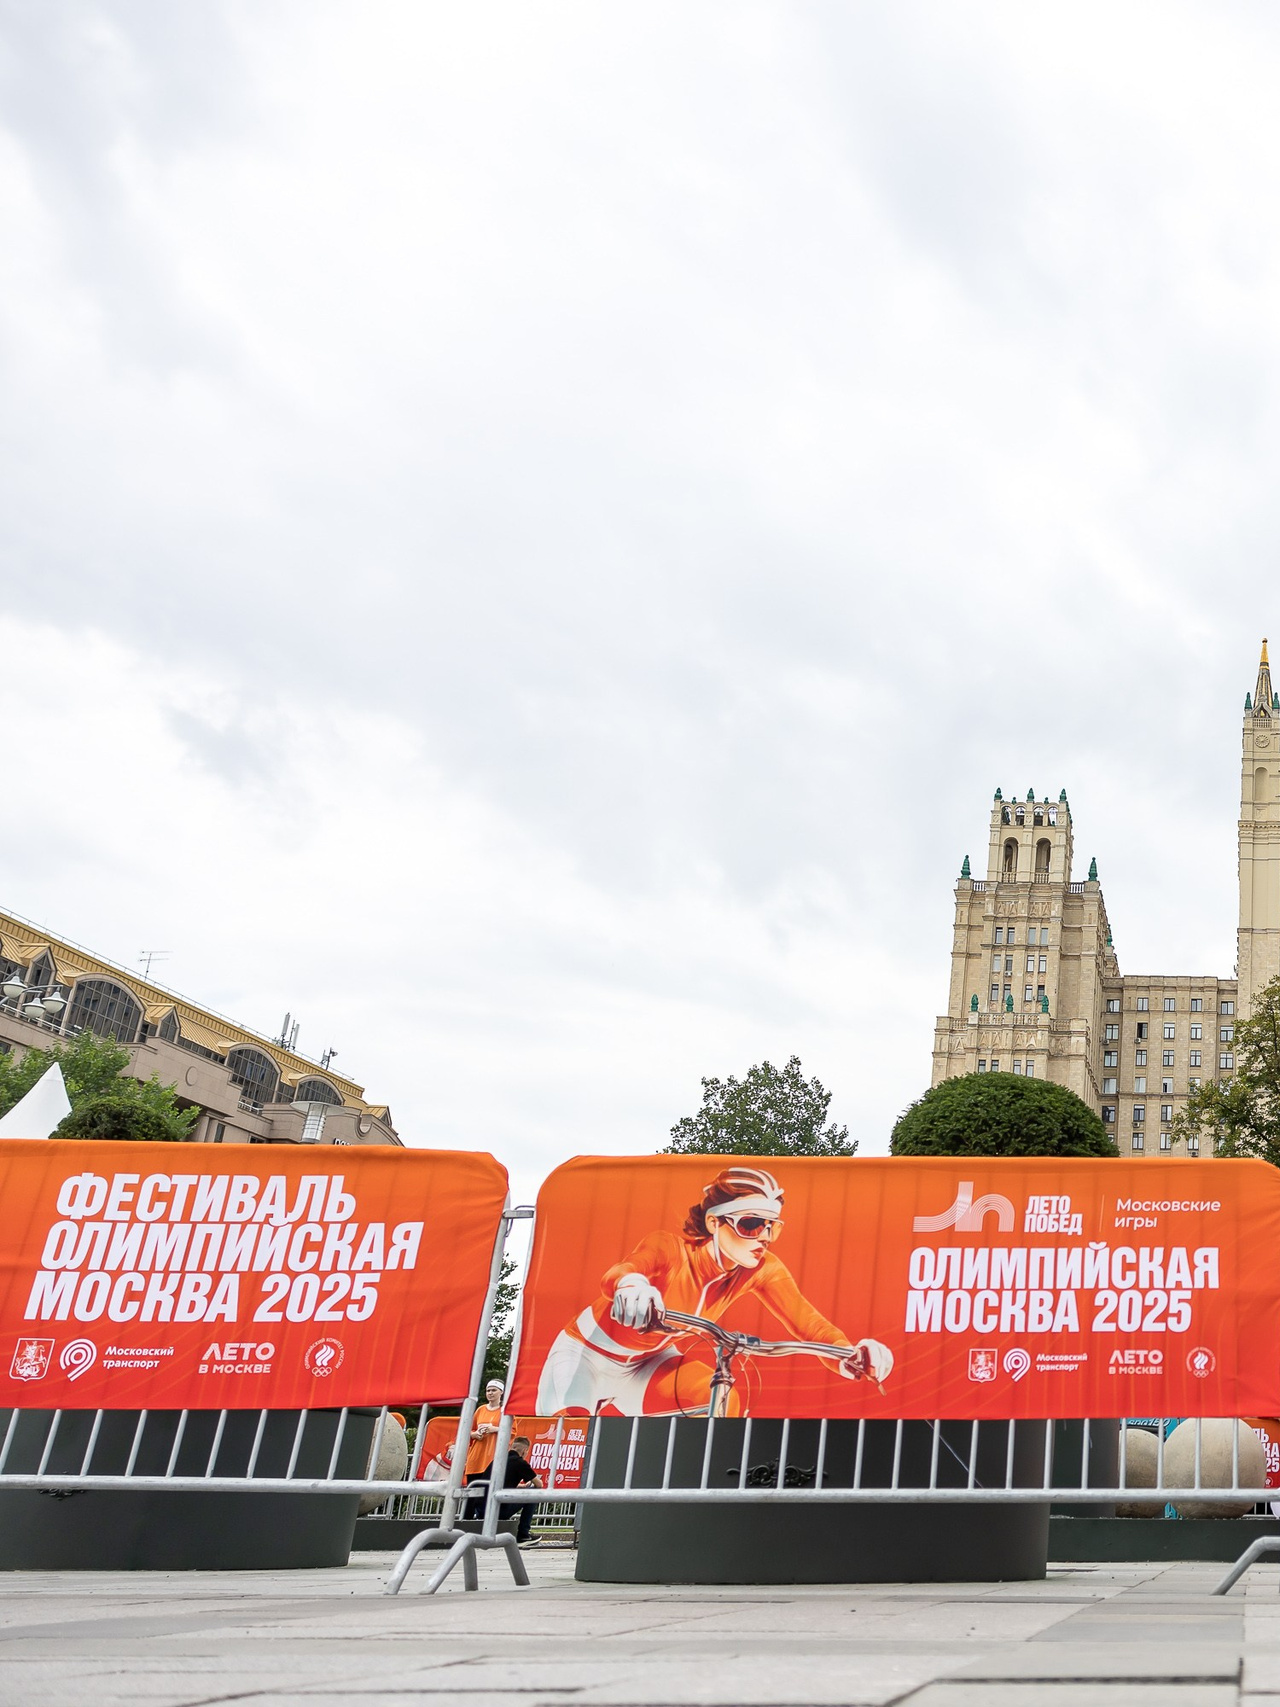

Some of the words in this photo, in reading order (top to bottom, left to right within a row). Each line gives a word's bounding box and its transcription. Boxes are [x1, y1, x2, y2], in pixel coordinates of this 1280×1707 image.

[56, 1172, 356, 1227] ФЕСТИВАЛЬ
[1025, 1195, 1071, 1214] ЛЕТО
[1116, 1198, 1221, 1212] Московские
[1023, 1213, 1083, 1236] ПОБЕД
[1114, 1216, 1158, 1231] игры
[40, 1217, 424, 1272] ОЛИМПИЙСКАЯ
[908, 1242, 1220, 1291] ОЛИМПИЙСКАЯ
[23, 1270, 239, 1322] МОСКВА
[252, 1272, 381, 1323] 2025
[905, 1289, 1080, 1334] МОСКВА
[1092, 1289, 1192, 1334] 2025
[104, 1346, 174, 1356] Московский
[201, 1342, 276, 1361] ЛЕТО
[1036, 1353, 1088, 1362] Московский
[1108, 1349, 1164, 1365] ЛЕТО
[102, 1359, 160, 1370] транспорт
[198, 1364, 209, 1374] В
[212, 1364, 272, 1374] МОСКВЕ
[1036, 1363, 1079, 1372] транспорт
[1108, 1366, 1116, 1375] В
[1118, 1366, 1163, 1375] МОСКВЕ
